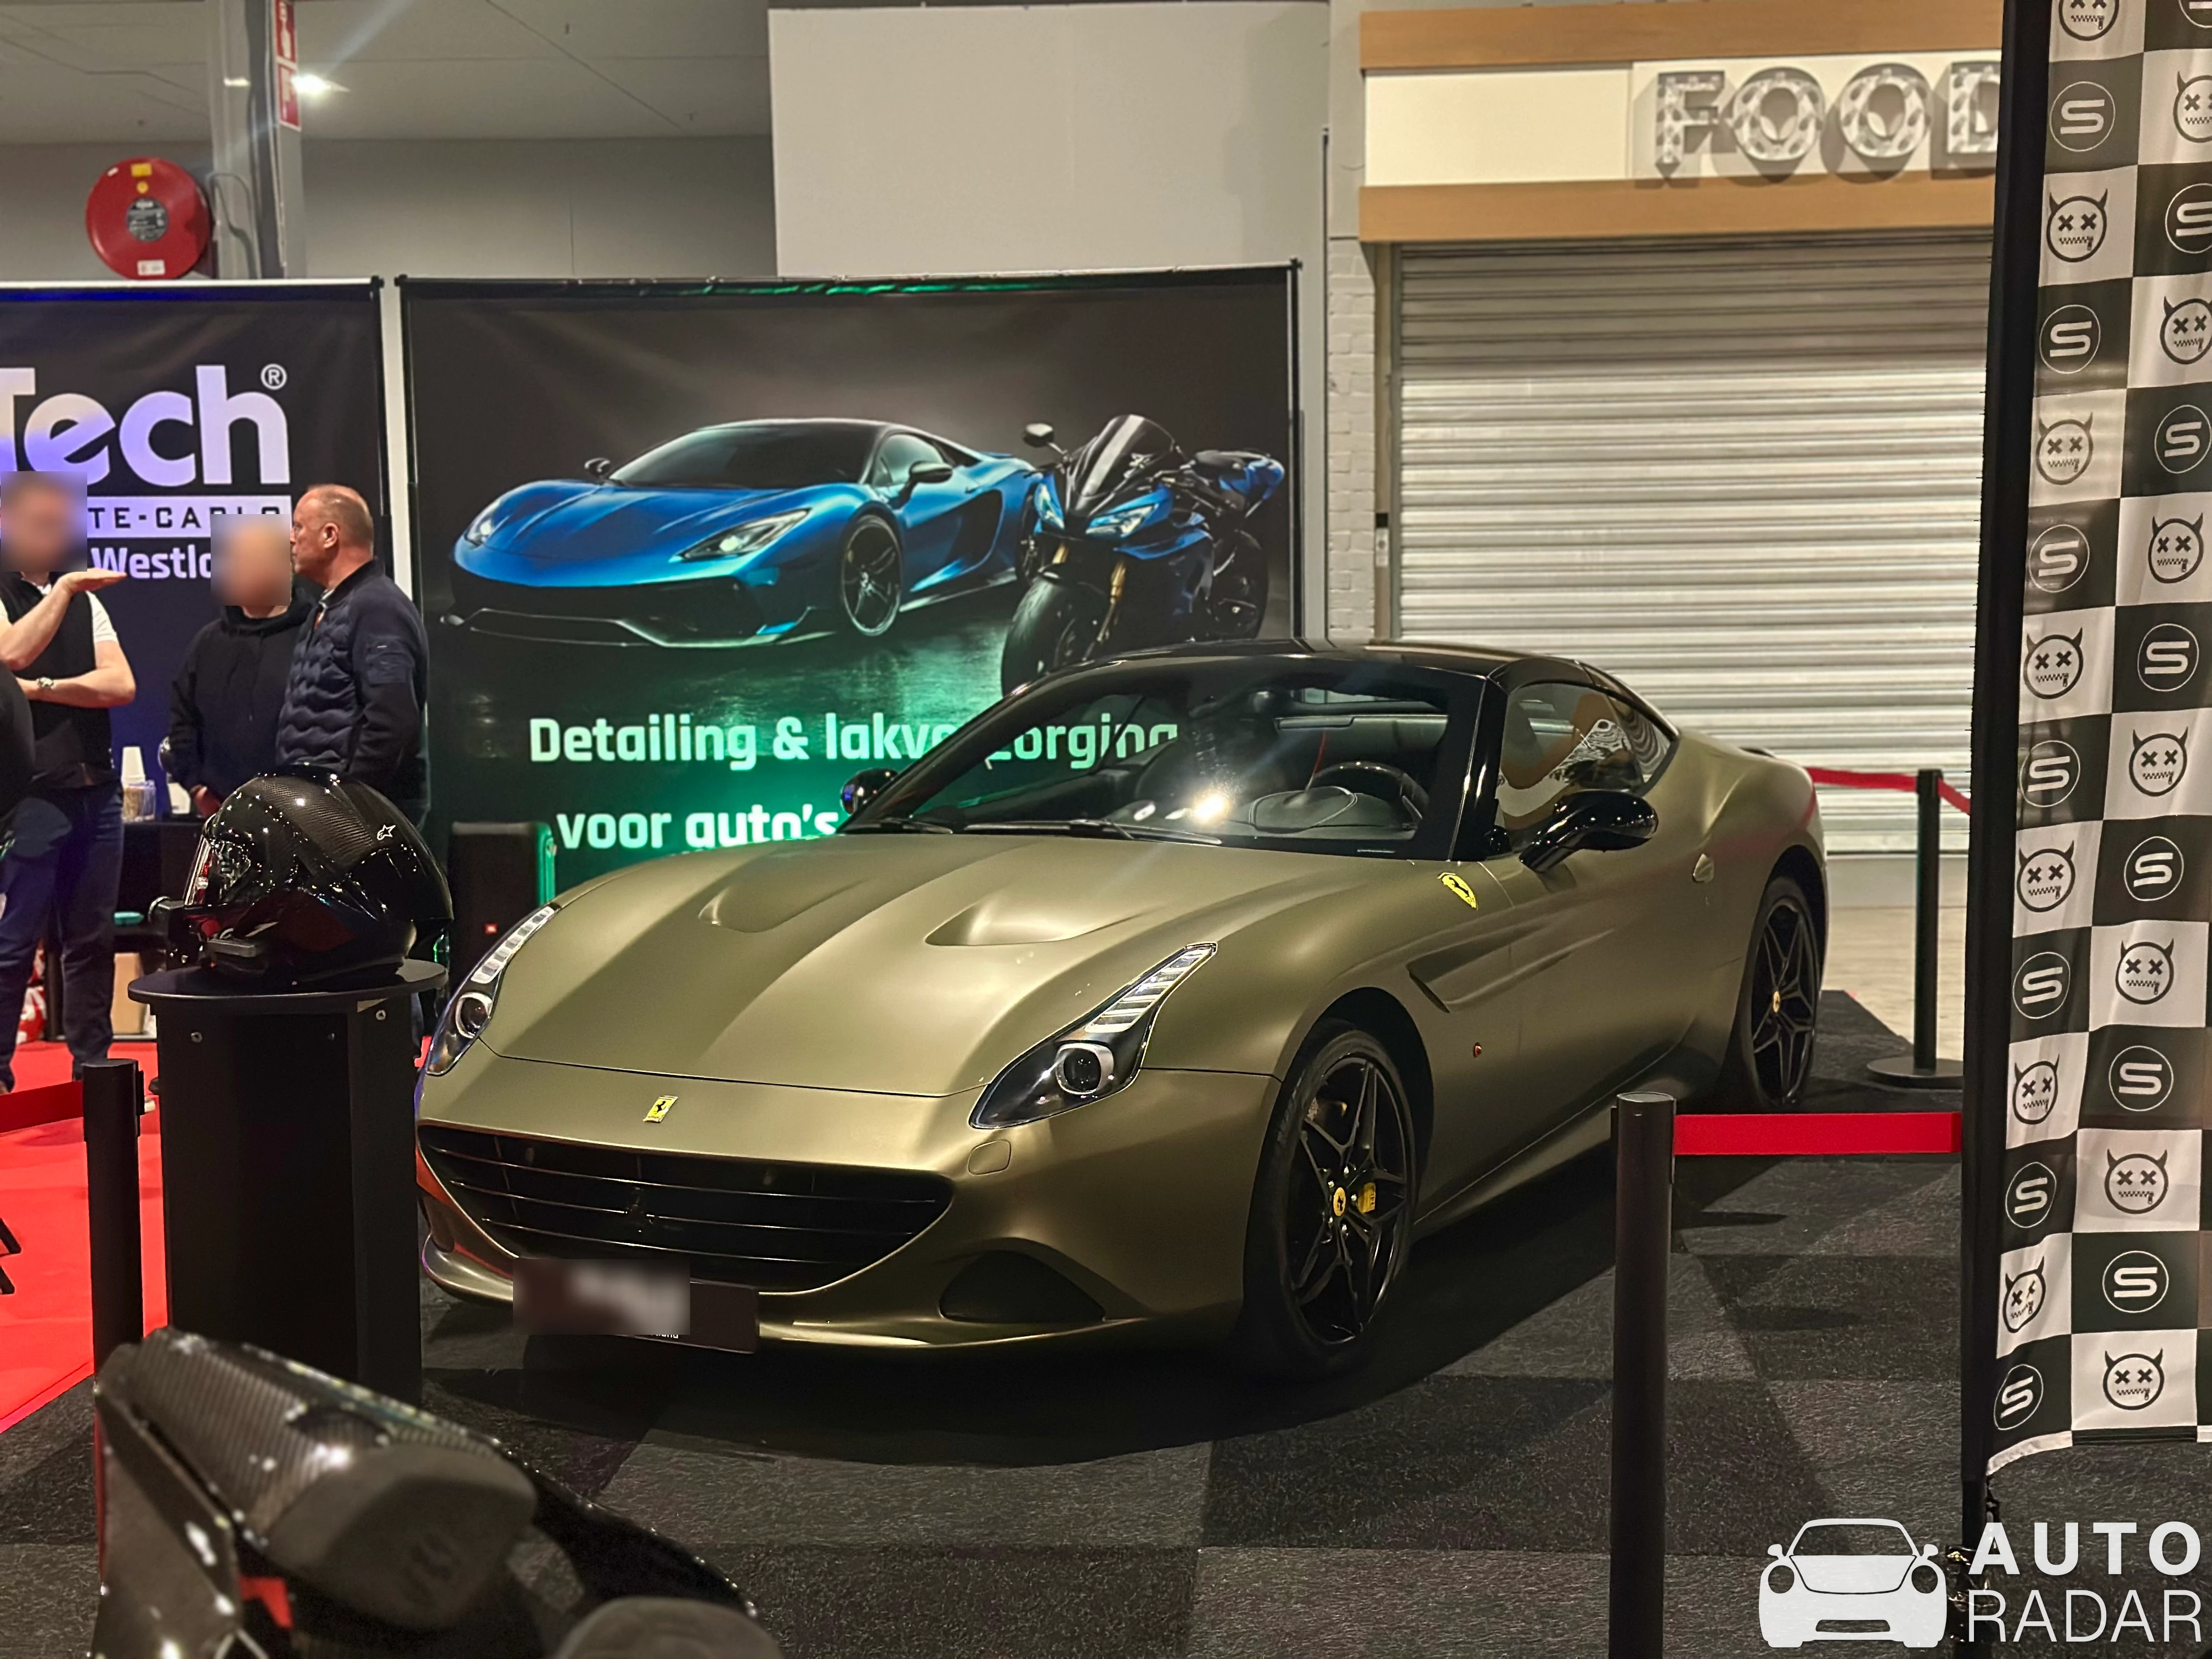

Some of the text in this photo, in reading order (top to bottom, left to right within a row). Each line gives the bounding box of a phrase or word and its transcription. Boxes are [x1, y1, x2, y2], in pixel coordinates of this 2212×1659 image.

[530, 713, 757, 771] Detailing
[773, 716, 810, 760] &
[556, 803, 839, 849] voor auto's
